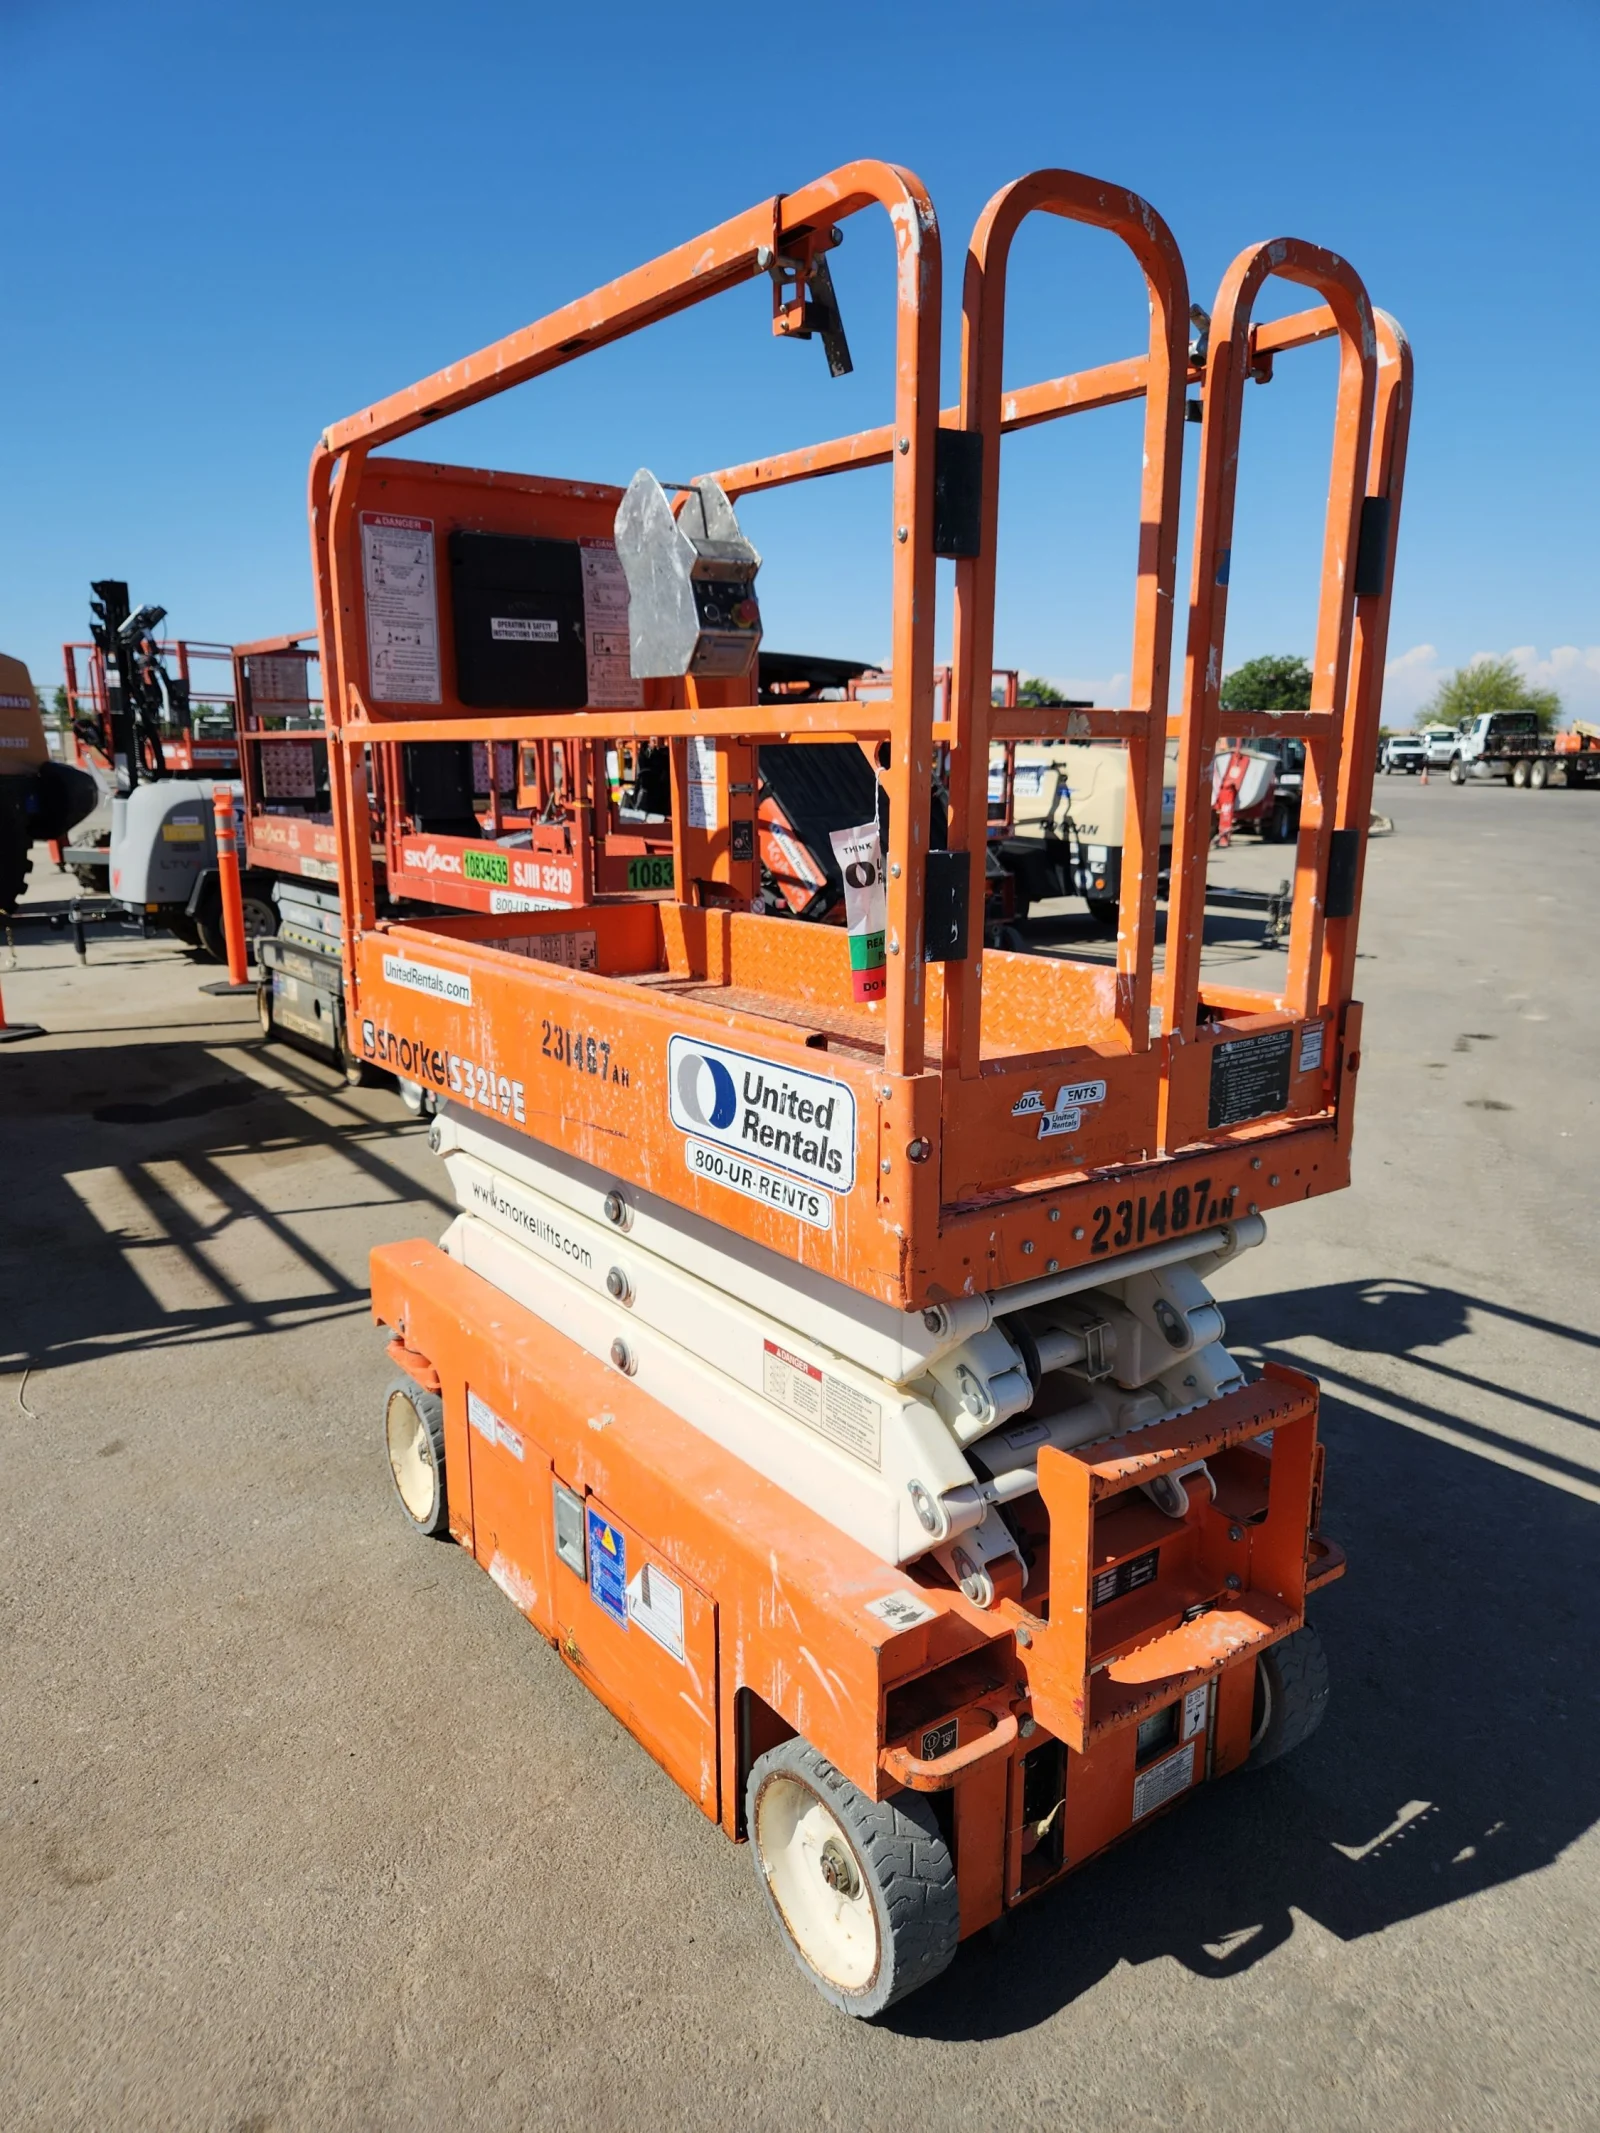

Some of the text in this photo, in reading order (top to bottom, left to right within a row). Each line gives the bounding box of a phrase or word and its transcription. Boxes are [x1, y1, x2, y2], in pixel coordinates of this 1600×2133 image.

[382, 516, 421, 529] DANGER
[497, 621, 526, 629] OPERATING
[533, 622, 552, 631] SAFETY
[404, 844, 462, 874] SKYJACK
[465, 854, 508, 884] 10834539
[541, 865, 572, 895] 3219
[843, 842, 873, 855] THINK
[384, 961, 470, 1001] UnitedRentals.com
[863, 981, 879, 992] DO
[377, 1028, 451, 1088] snorkel
[450, 1054, 526, 1124] S3219E
[541, 1018, 630, 1089] 231487 AH
[743, 1071, 836, 1132] United
[1052, 1112, 1076, 1122] United
[741, 1108, 843, 1175] Rentals
[1051, 1120, 1078, 1130] Rentals
[695, 1149, 820, 1218] 800-UR-RENTS
[472, 1181, 592, 1269] www.snorkellifts.com
[1091, 1178, 1234, 1254] 231487 AH
[781, 1350, 809, 1374] DANGER
